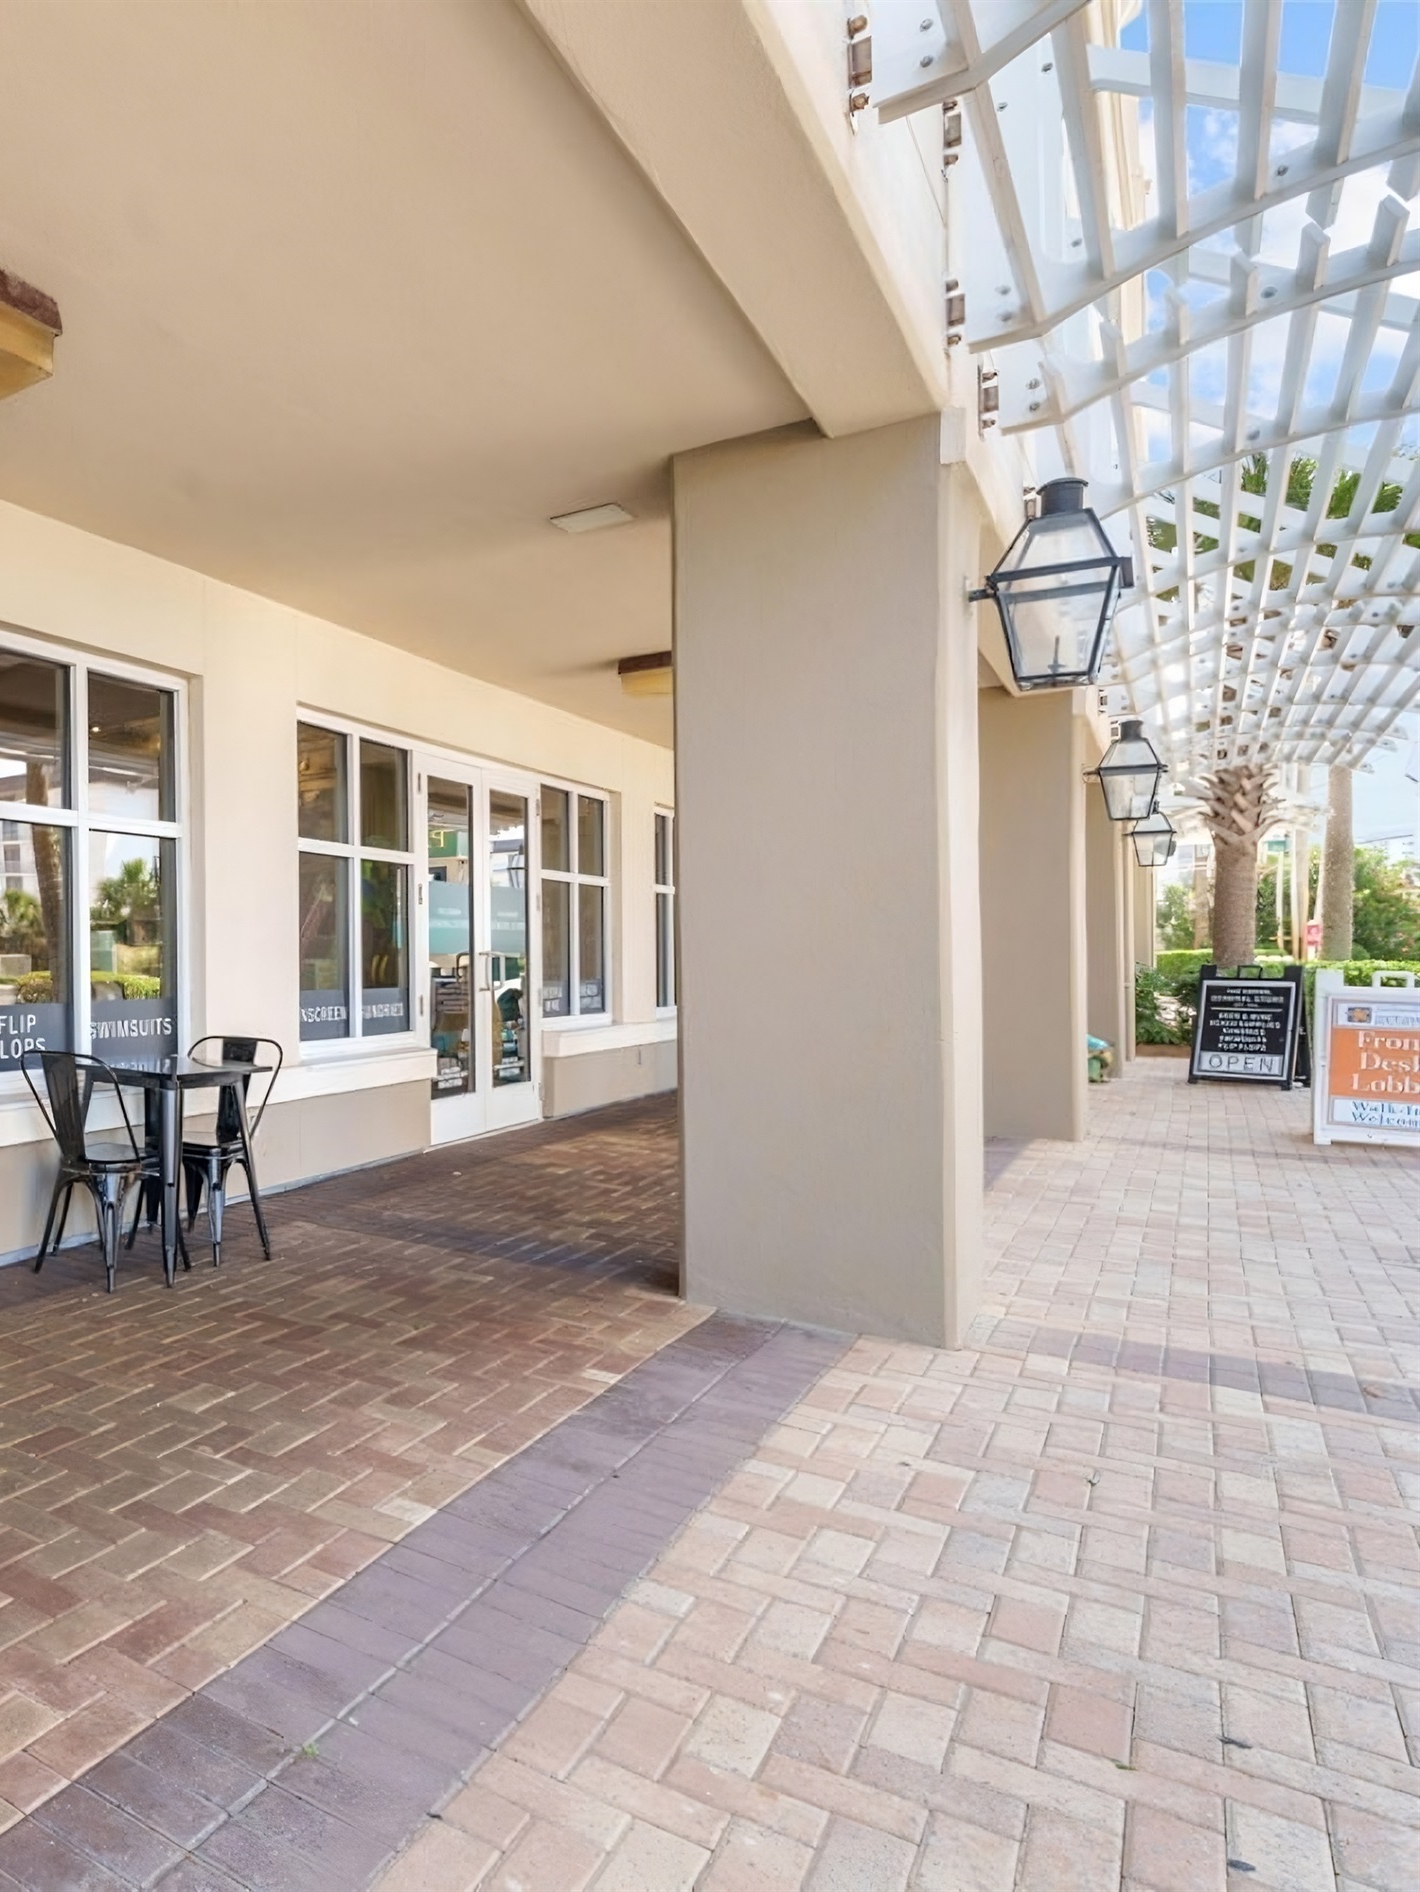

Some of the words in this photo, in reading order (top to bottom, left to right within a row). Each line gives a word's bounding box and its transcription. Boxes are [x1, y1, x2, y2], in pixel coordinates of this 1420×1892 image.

[89, 1018, 172, 1040] SWIMSUITS
[1357, 1030, 1420, 1051] Fron
[1209, 1054, 1274, 1072] OPEN
[1351, 1073, 1420, 1094] Lobb
